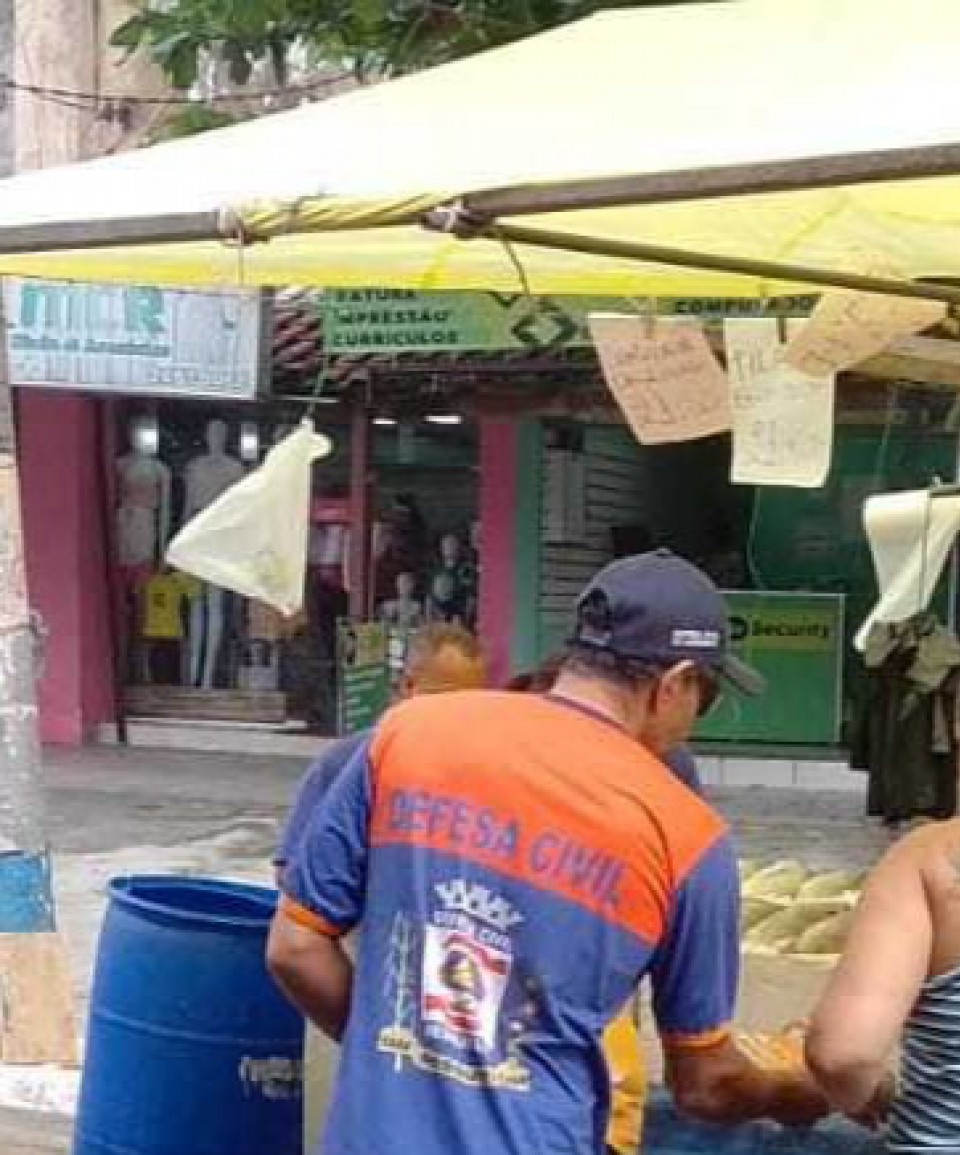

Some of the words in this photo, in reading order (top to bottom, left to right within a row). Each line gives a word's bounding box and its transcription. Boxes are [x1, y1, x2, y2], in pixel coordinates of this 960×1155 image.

[751, 619, 831, 641] Security
[390, 788, 520, 860] DEFESA
[530, 830, 624, 906] CIVIL
